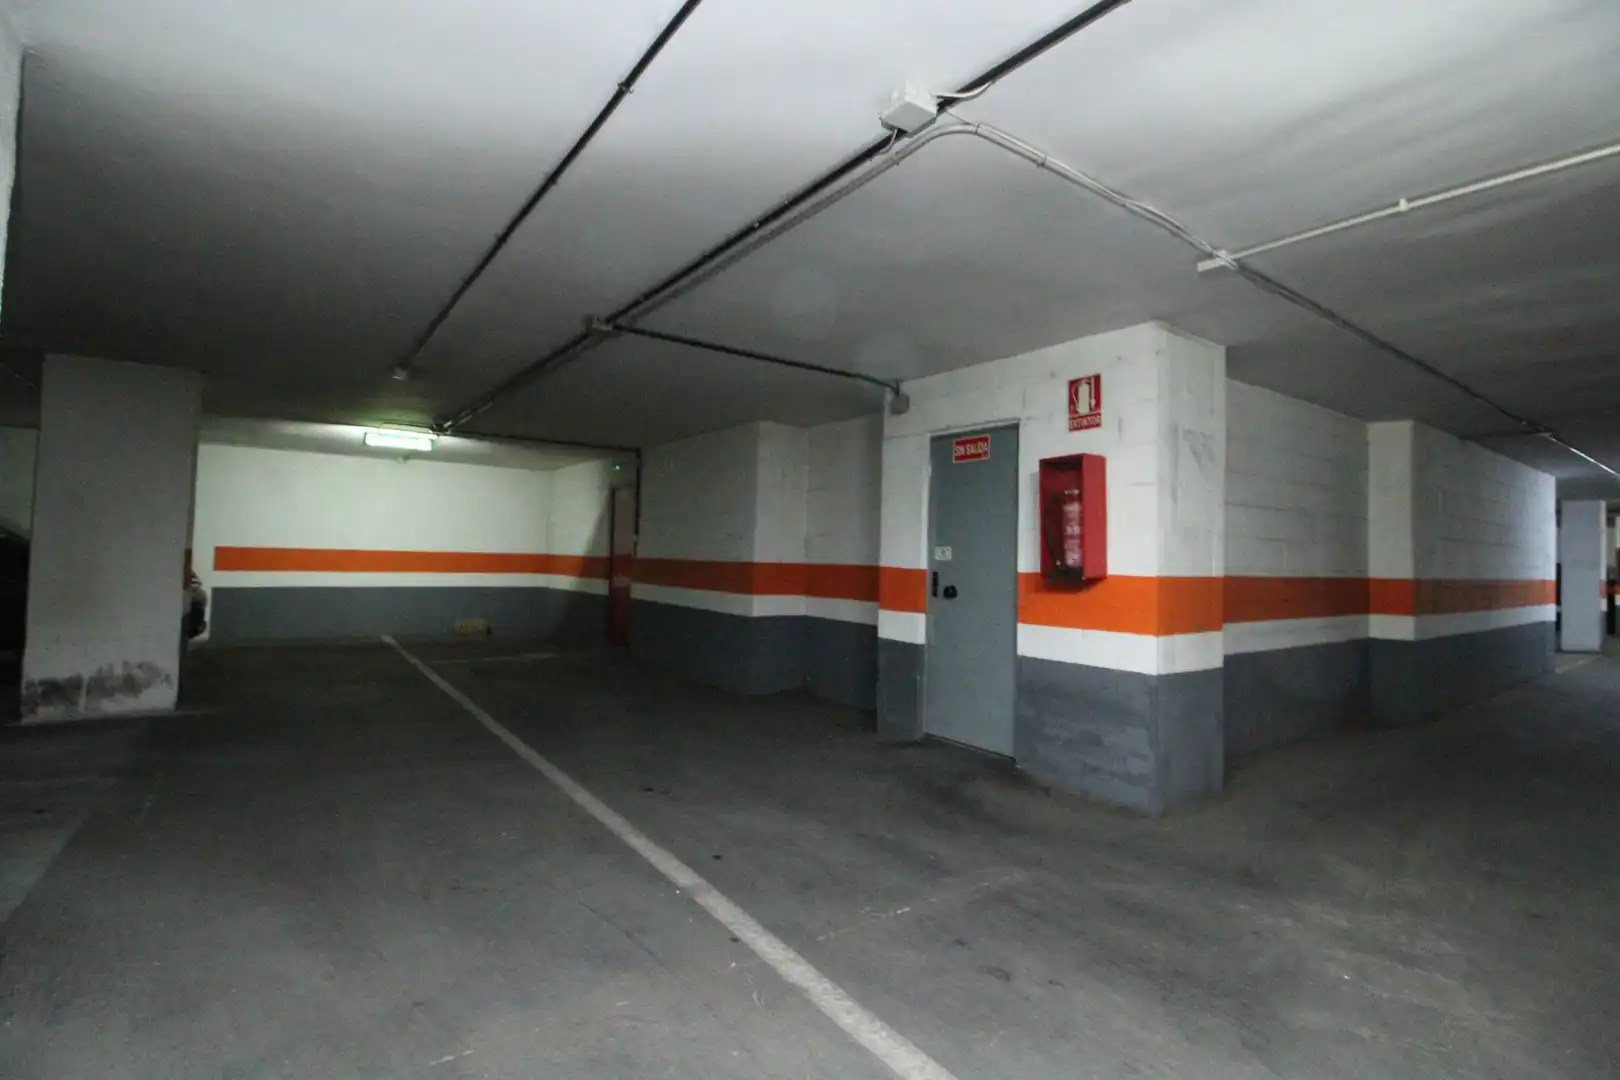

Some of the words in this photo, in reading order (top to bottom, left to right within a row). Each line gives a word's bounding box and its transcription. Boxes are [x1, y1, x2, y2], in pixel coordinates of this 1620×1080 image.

[1069, 415, 1100, 429] EXTINTOR
[954, 446, 965, 456] SIN
[966, 442, 988, 455] SALIDA
